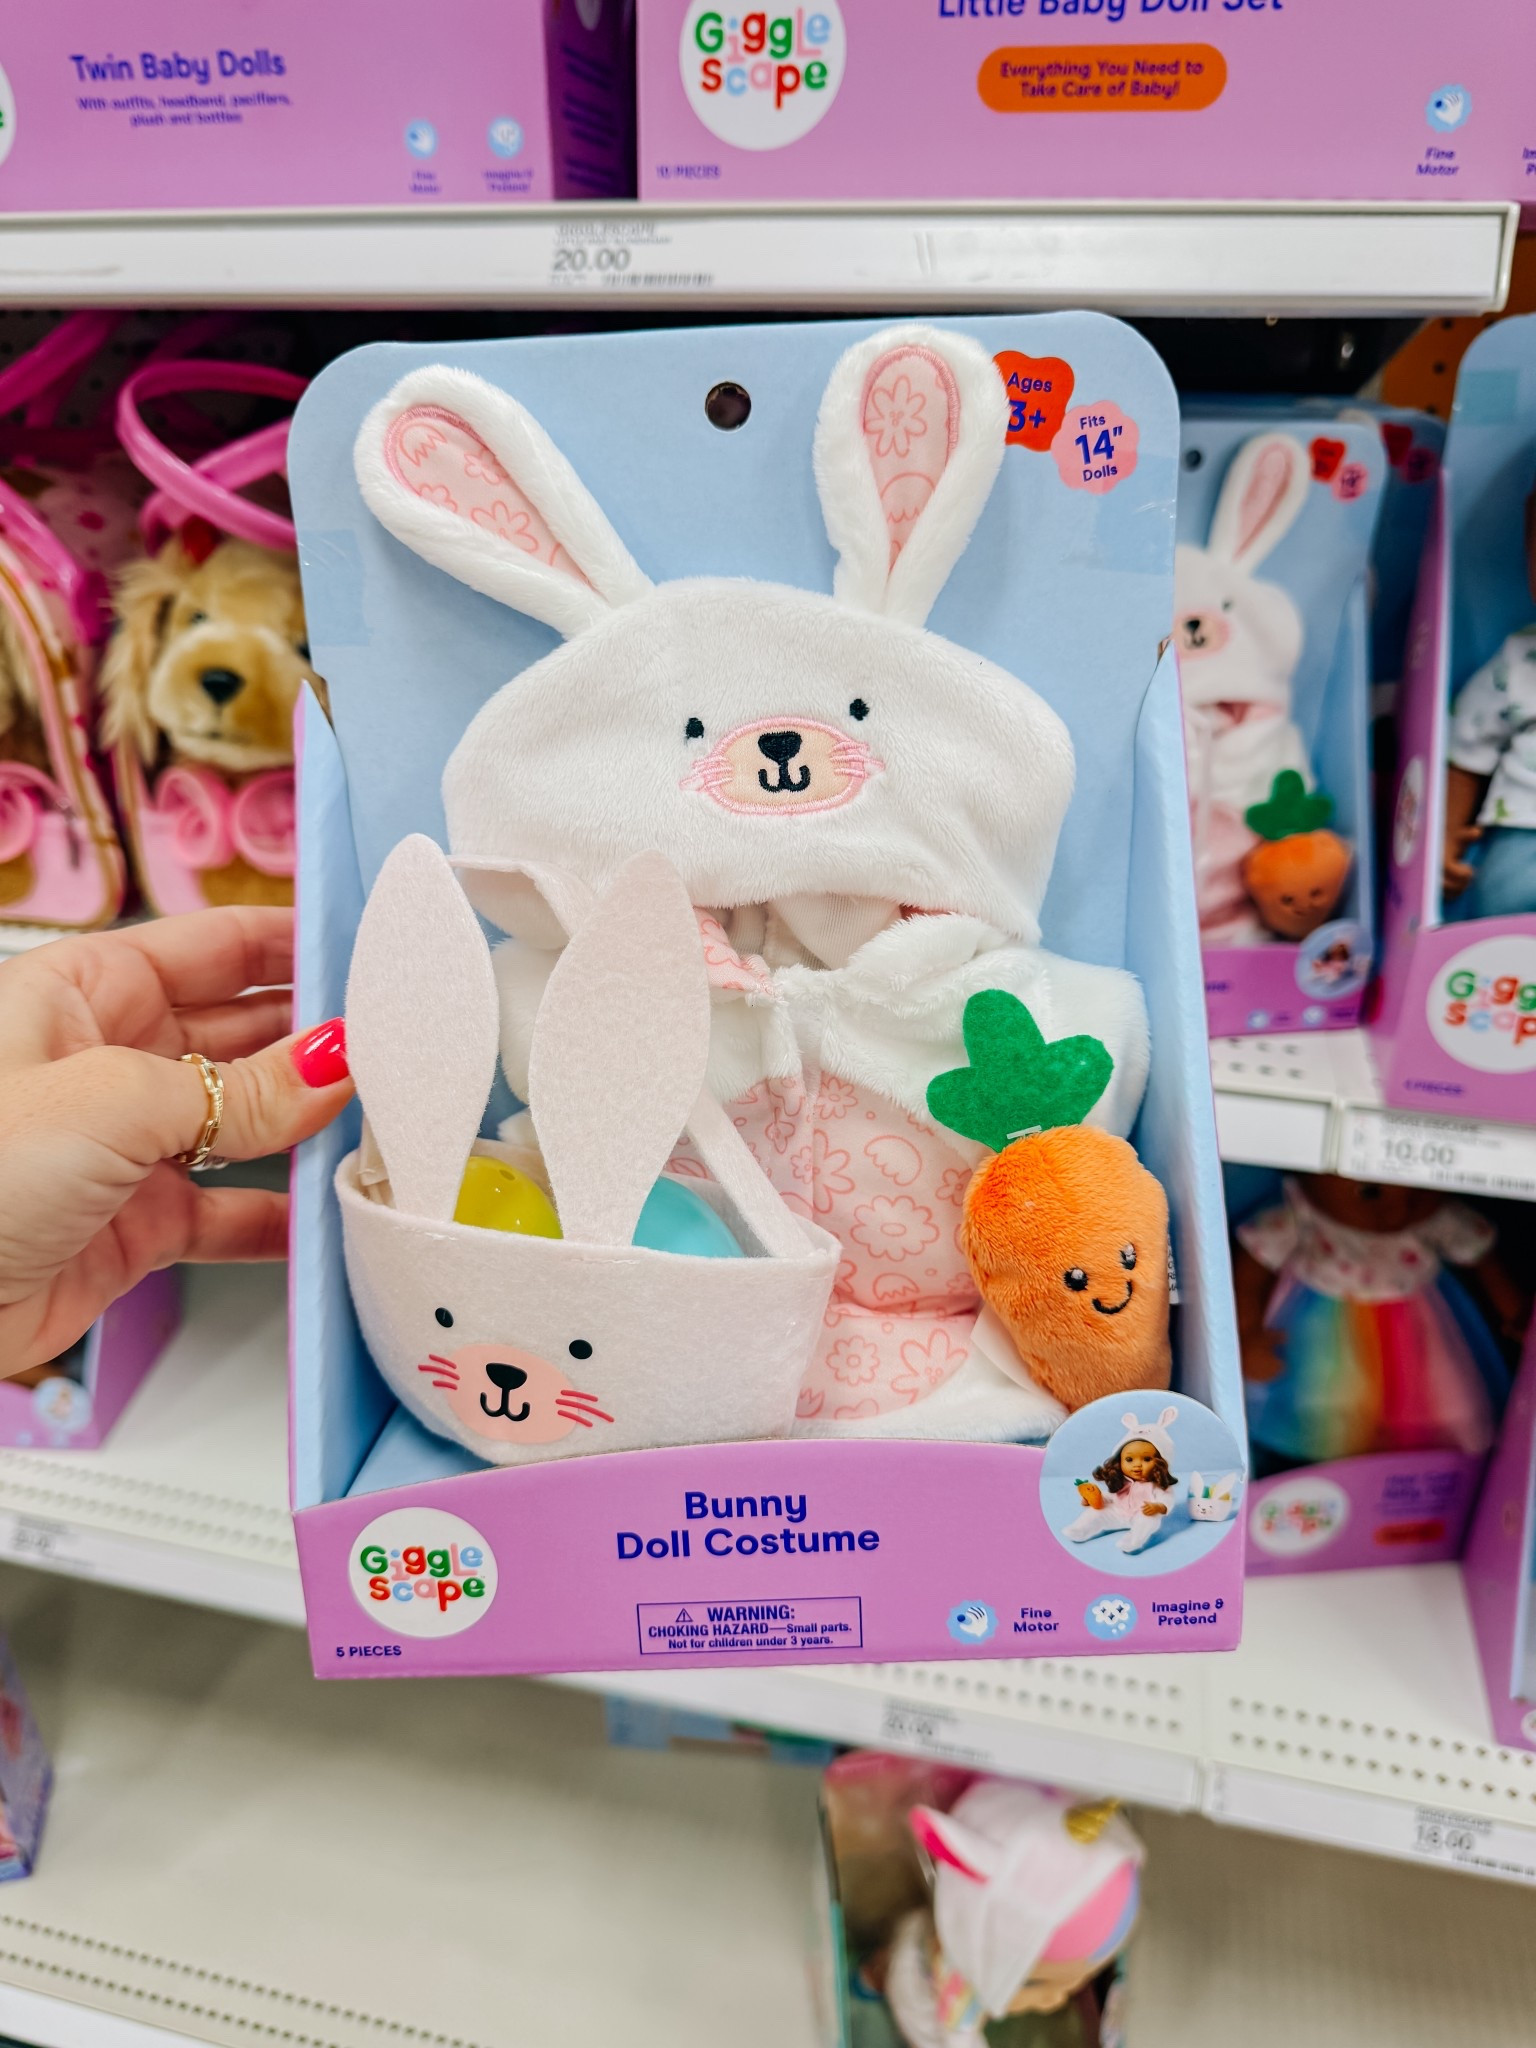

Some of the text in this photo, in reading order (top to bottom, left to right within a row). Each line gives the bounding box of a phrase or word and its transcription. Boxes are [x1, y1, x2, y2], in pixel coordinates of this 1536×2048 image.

[939, 0, 1025, 17] Little
[1039, 0, 1126, 22] Baby
[70, 48, 286, 85] Twin Baby Dolls
[1000, 60, 1204, 80] Everything You Need to
[1021, 80, 1181, 100] Take Care of Baby!
[1425, 147, 1456, 160] Fine
[552, 248, 632, 272] 20.00
[1007, 371, 1053, 394] Ages
[1007, 399, 1047, 432] 3+
[1079, 415, 1106, 430] Fits
[1082, 464, 1119, 482] Dolls
[1384, 1138, 1456, 1167] 10.00
[684, 1491, 807, 1523] Bunny
[617, 1527, 880, 1560] Doll Costume
[706, 1604, 796, 1622] WARNING:
[1020, 1607, 1052, 1619] Fine
[1152, 1600, 1211, 1615] Imagine
[1013, 1620, 1060, 1633] Motor
[1158, 1612, 1218, 1627] Pretend
[648, 1624, 709, 1638] CHOKING
[820, 1620, 852, 1634] parts.
[668, 1635, 834, 1649] Not for children under 3 years.
[336, 1645, 402, 1658] 5 PIECES
